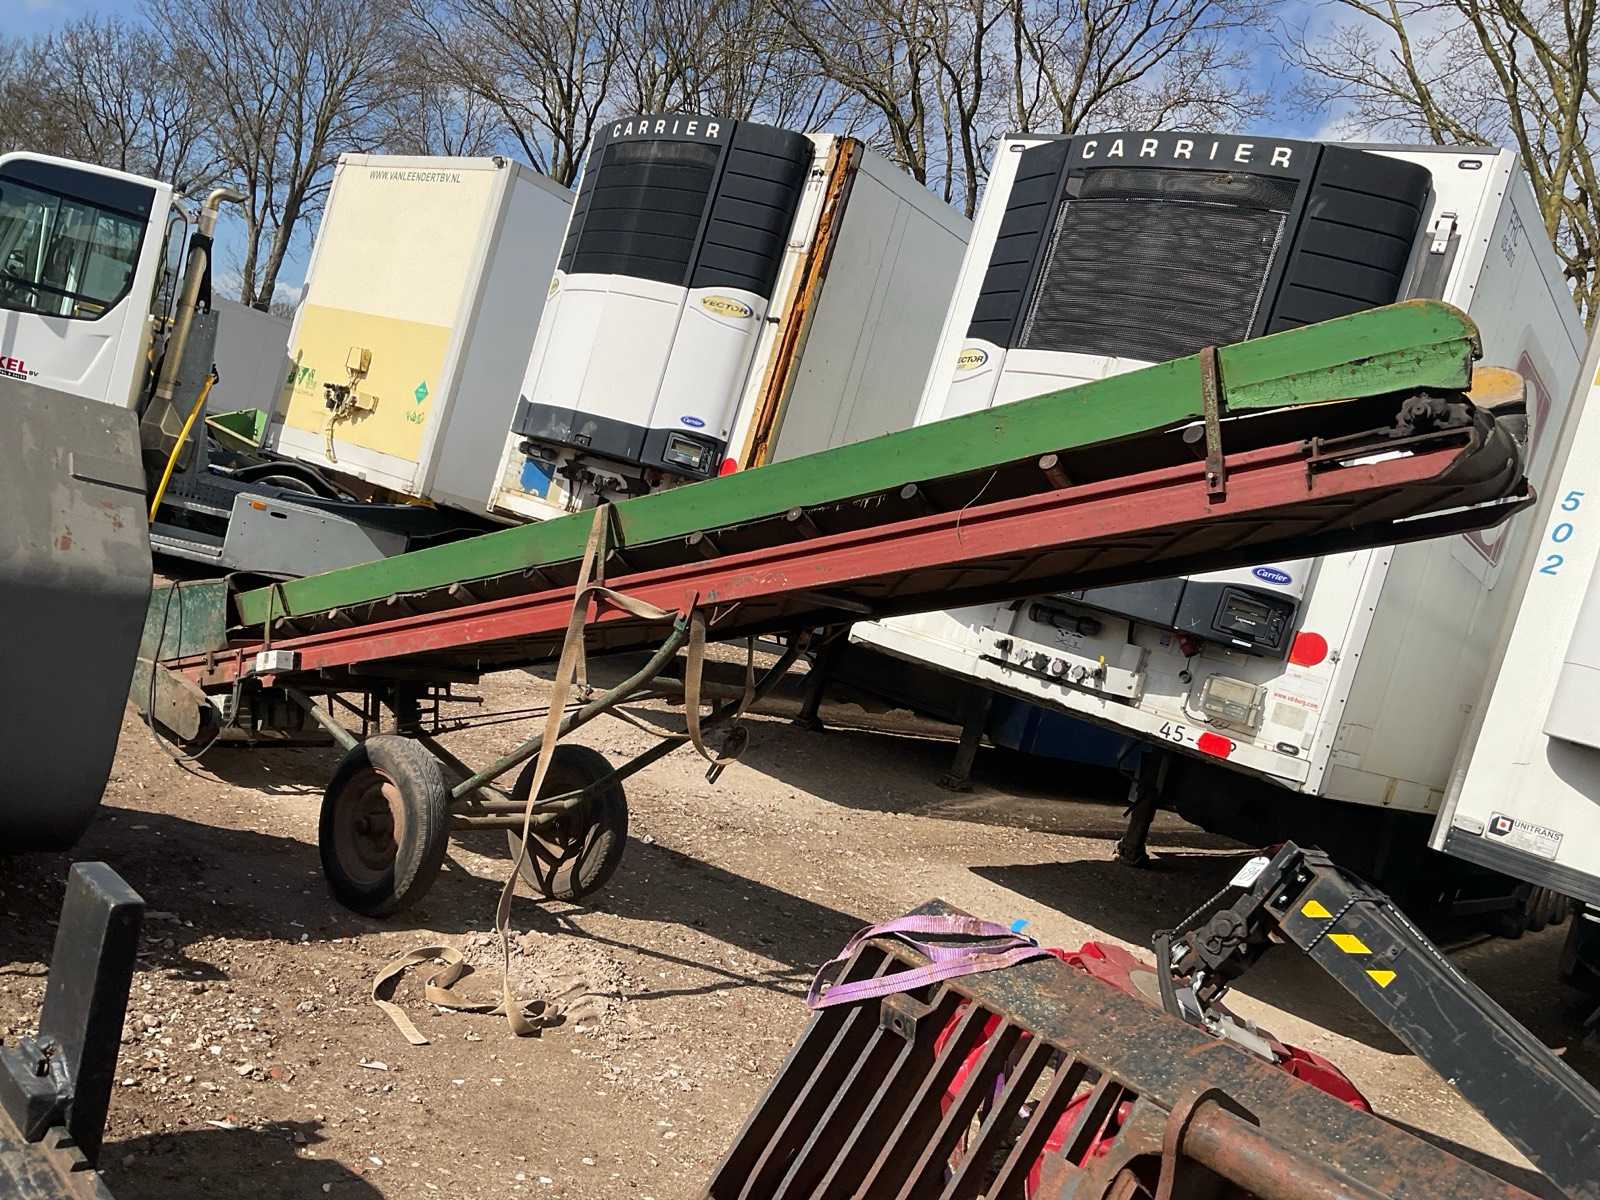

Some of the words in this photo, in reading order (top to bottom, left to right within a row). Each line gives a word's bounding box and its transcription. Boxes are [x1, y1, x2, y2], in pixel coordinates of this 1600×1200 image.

[613, 120, 719, 138] CARRIER
[1082, 138, 1292, 168] CARRIER
[369, 170, 461, 183] WWW.VANLEENDERTBV.NL
[703, 299, 748, 314] VECTOR
[1256, 569, 1288, 582] Carrier
[1513, 820, 1560, 841] UNITRANS
